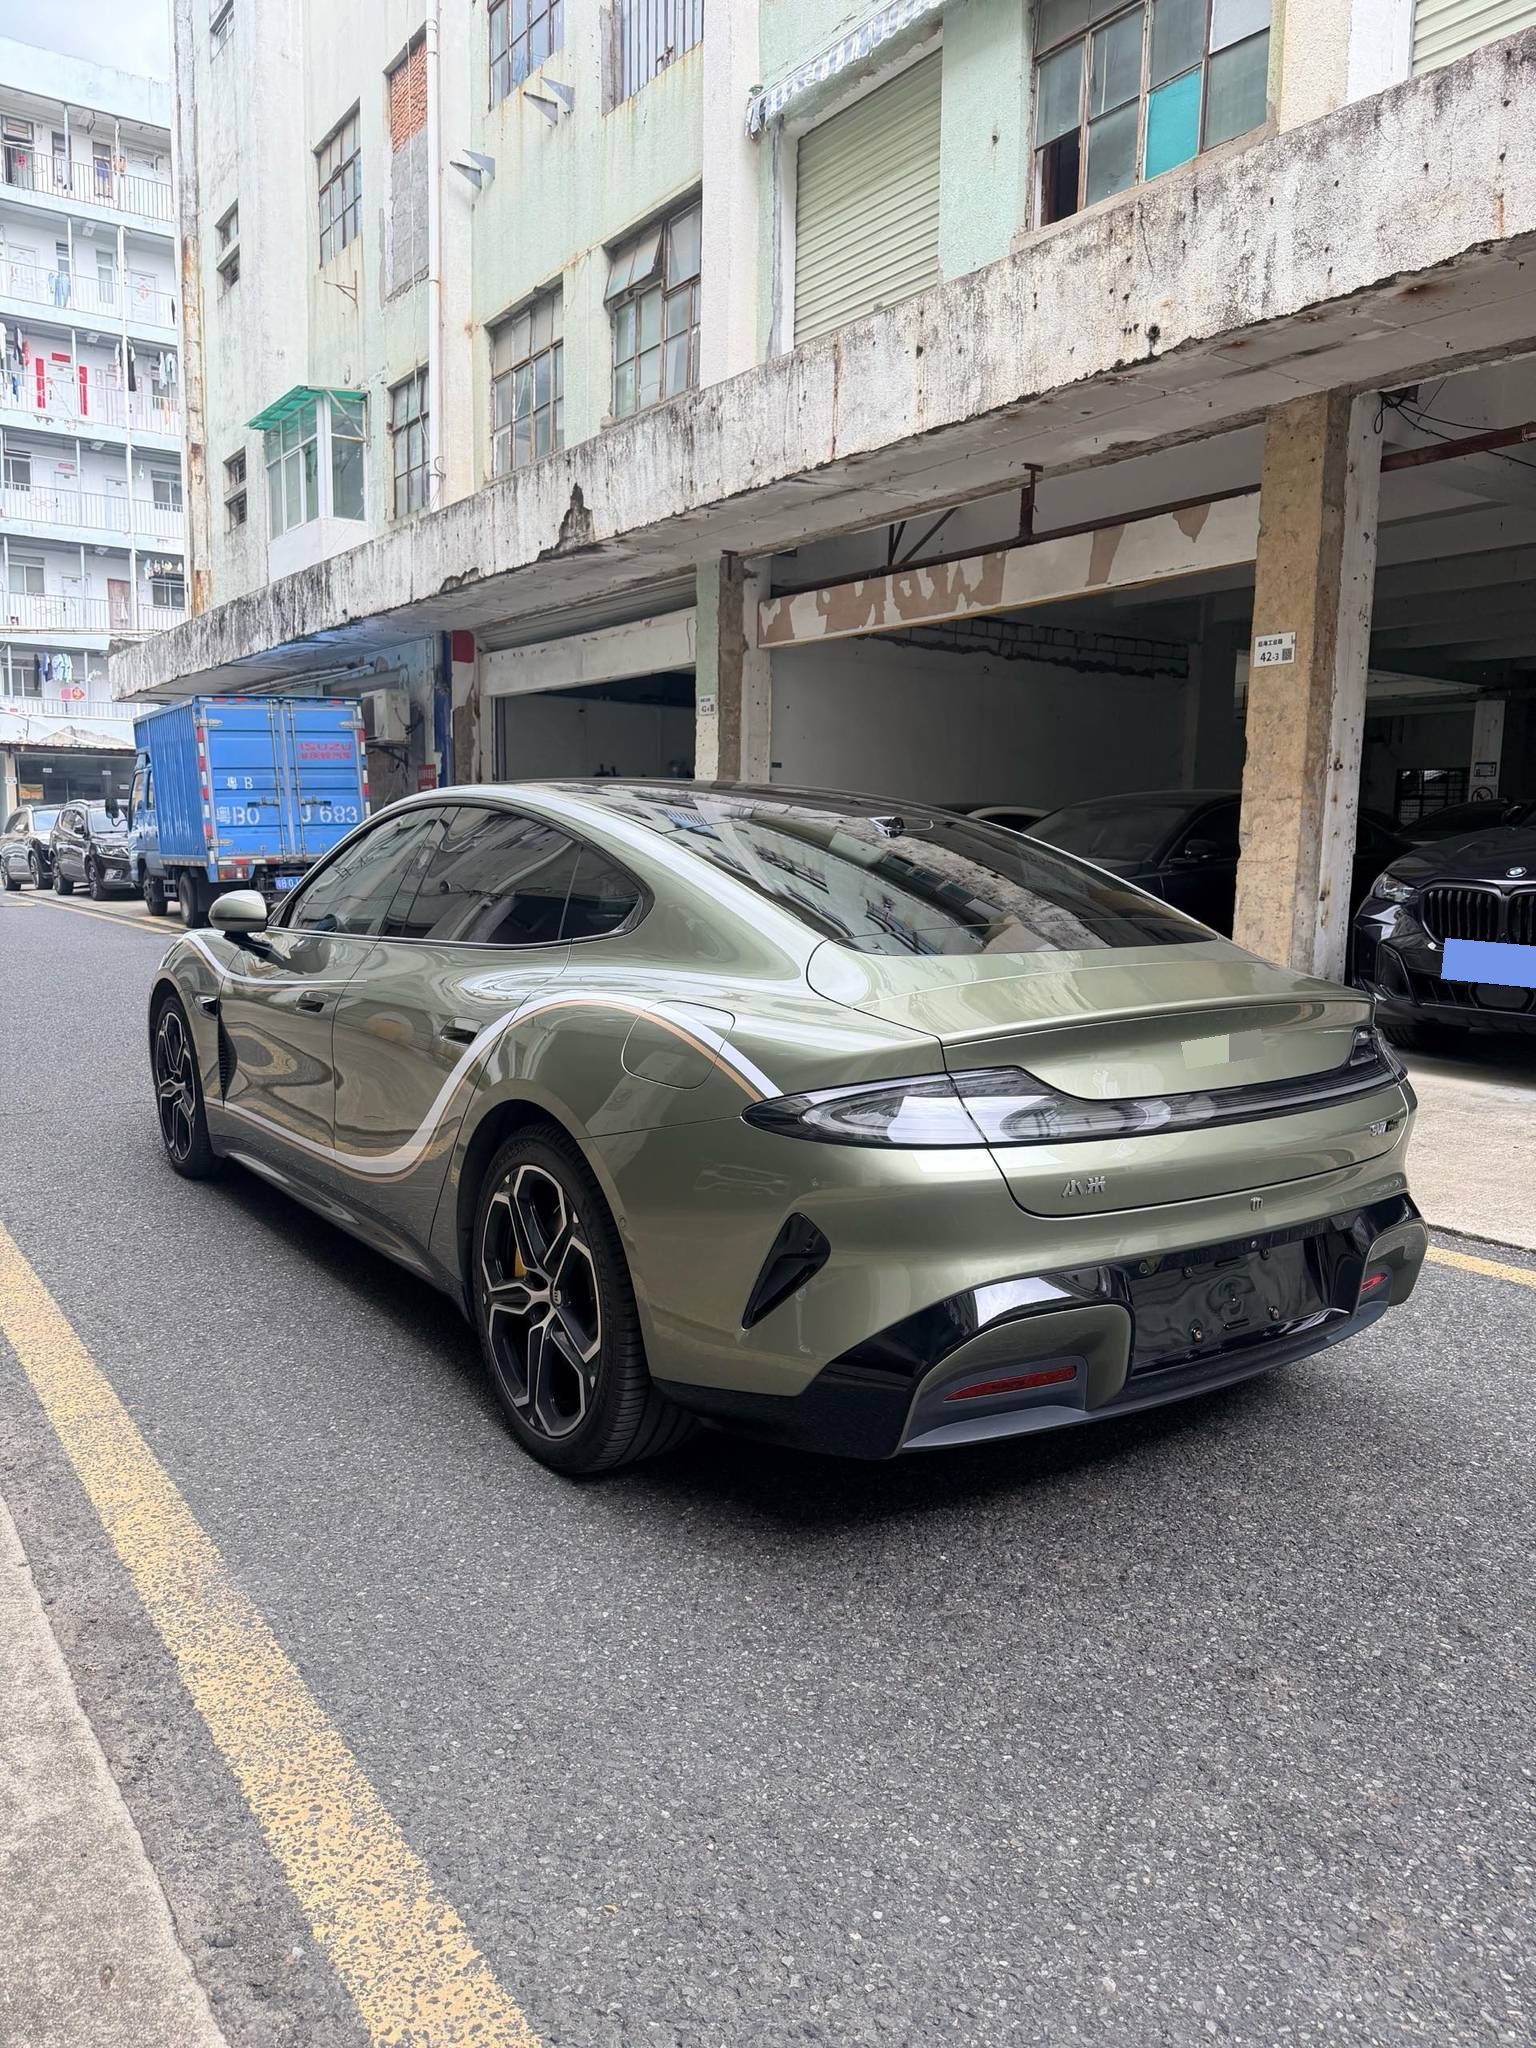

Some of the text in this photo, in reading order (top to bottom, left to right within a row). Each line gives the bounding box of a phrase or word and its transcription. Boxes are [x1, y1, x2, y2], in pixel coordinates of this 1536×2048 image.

[1260, 651, 1280, 663] 42-3
[299, 742, 352, 751] ISUZU
[244, 777, 254, 789] B
[1060, 1175, 1106, 1198] 小米
